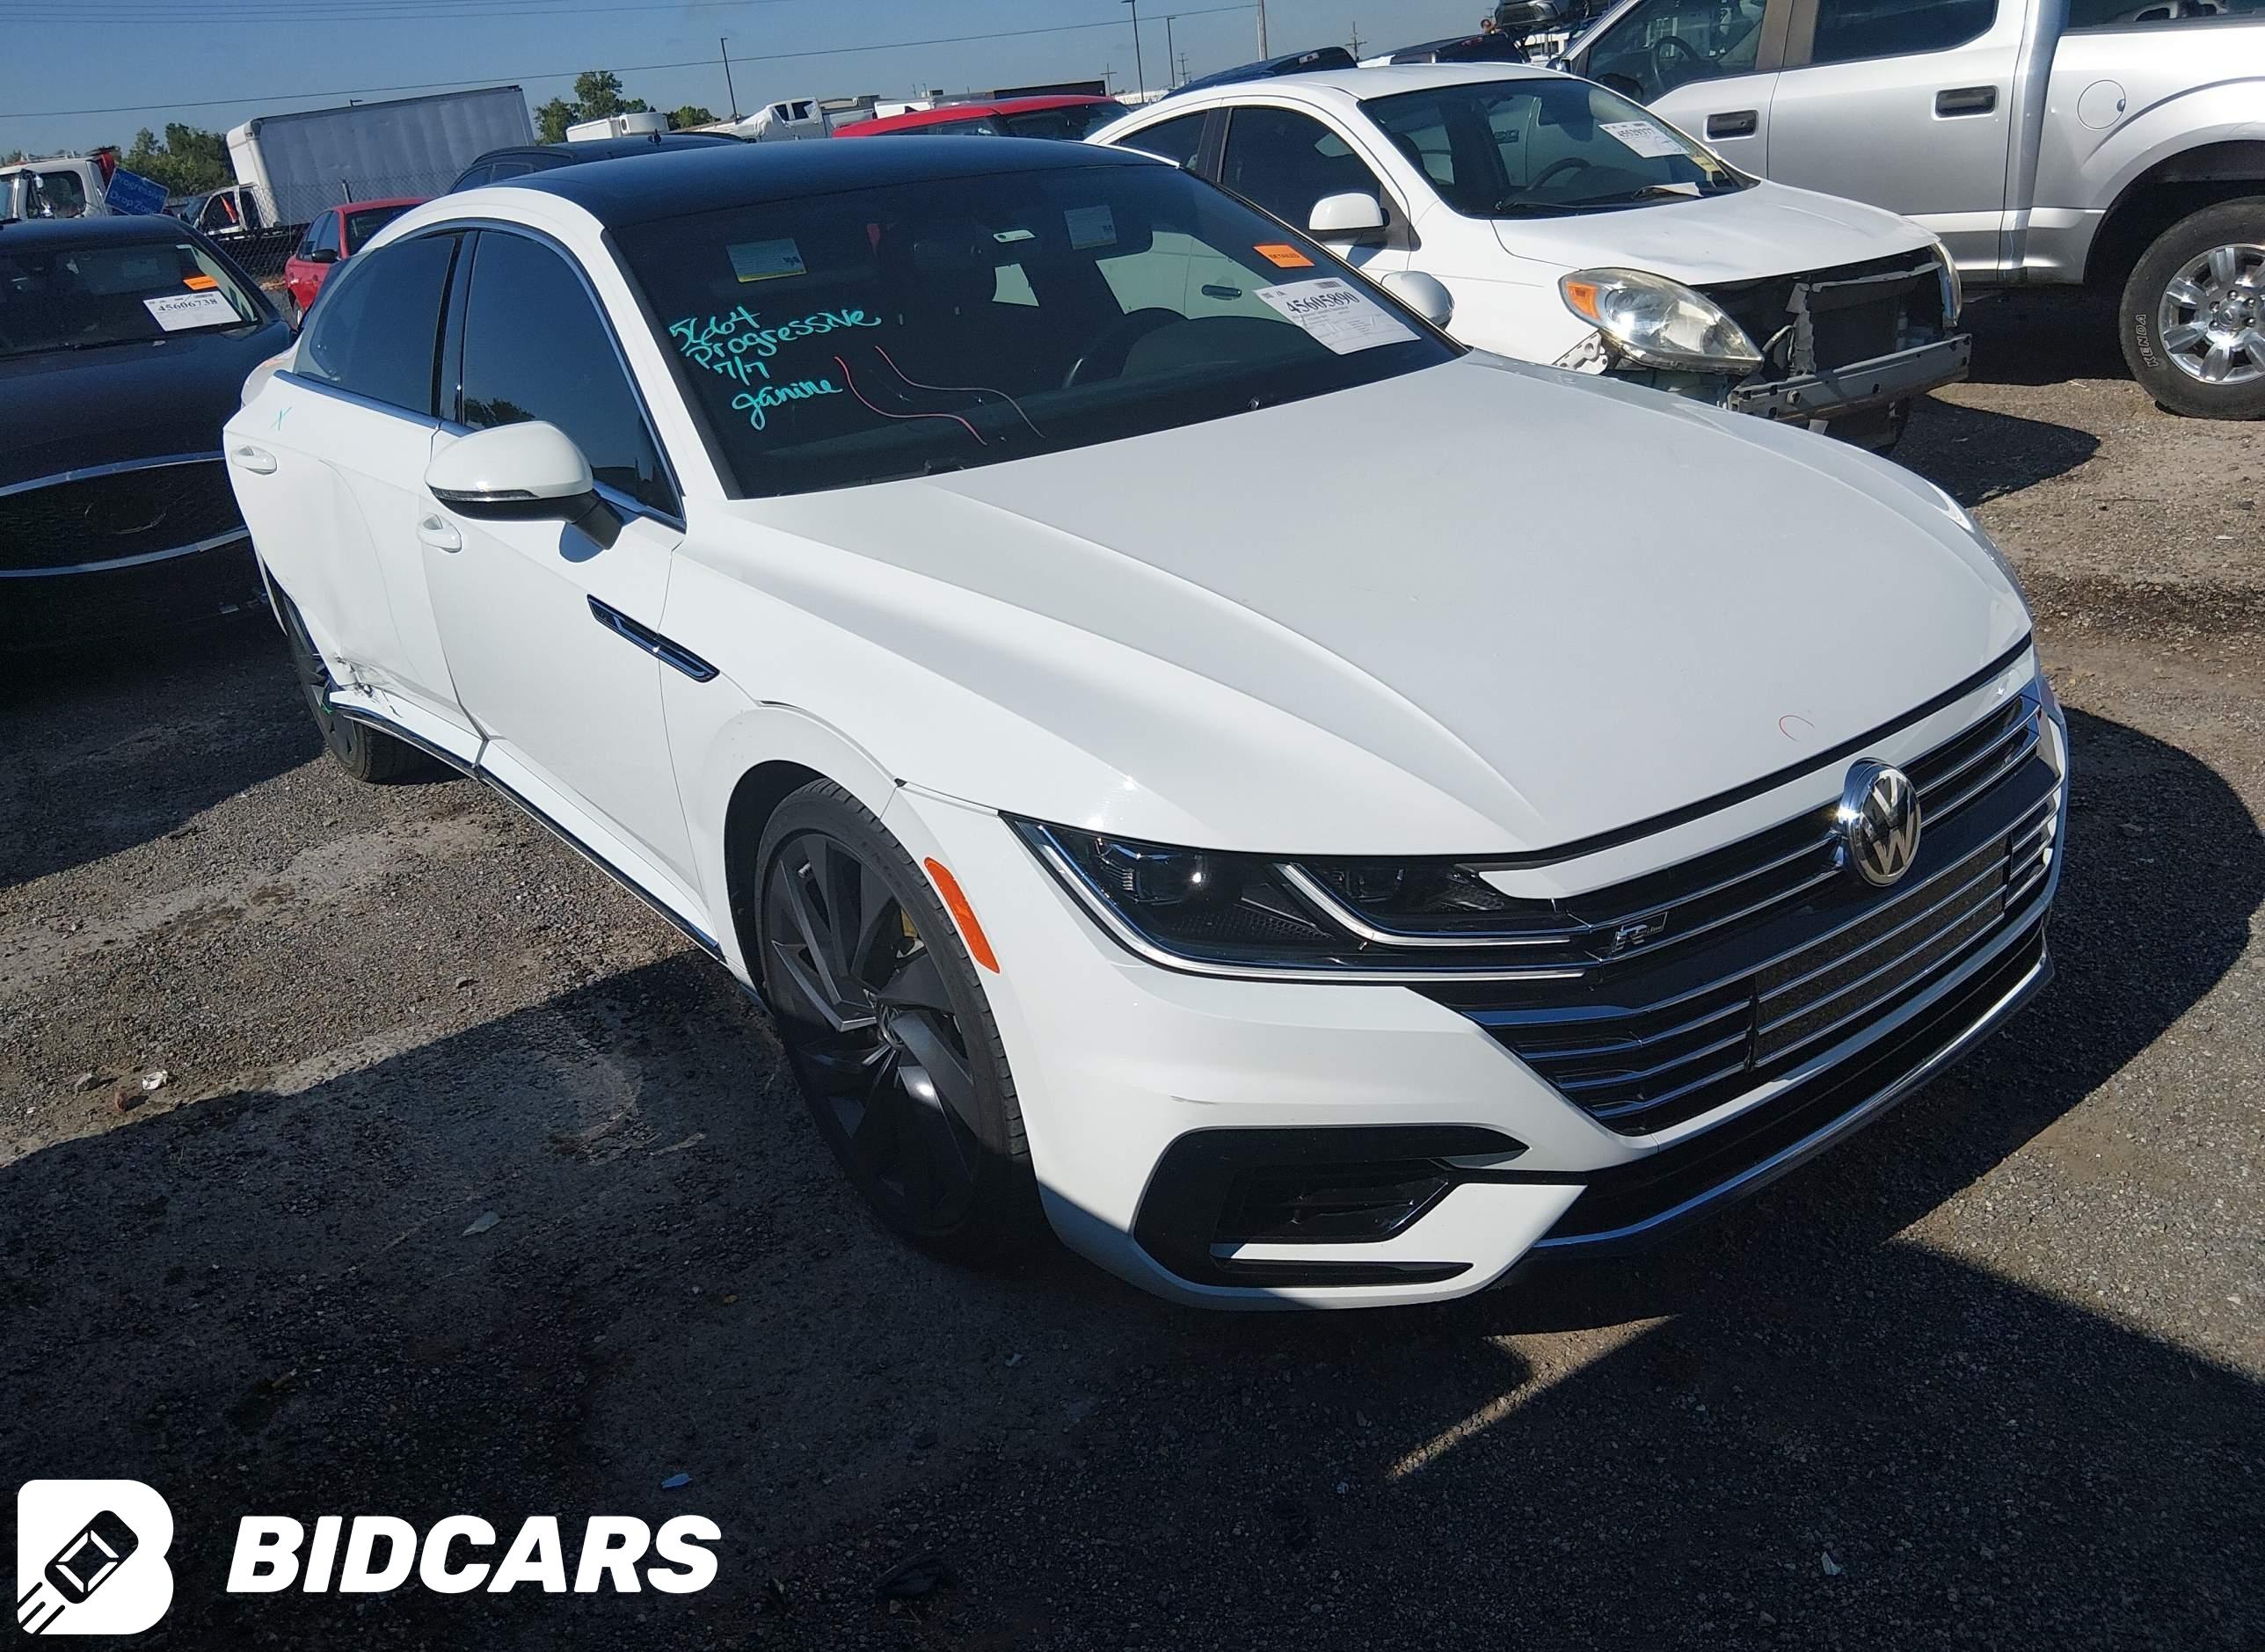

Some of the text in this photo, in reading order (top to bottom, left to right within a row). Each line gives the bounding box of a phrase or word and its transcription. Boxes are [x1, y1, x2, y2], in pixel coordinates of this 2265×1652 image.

[110, 190, 134, 207] Drop
[1285, 291, 1360, 314] 45605890
[2135, 314, 2159, 368] KENDA
